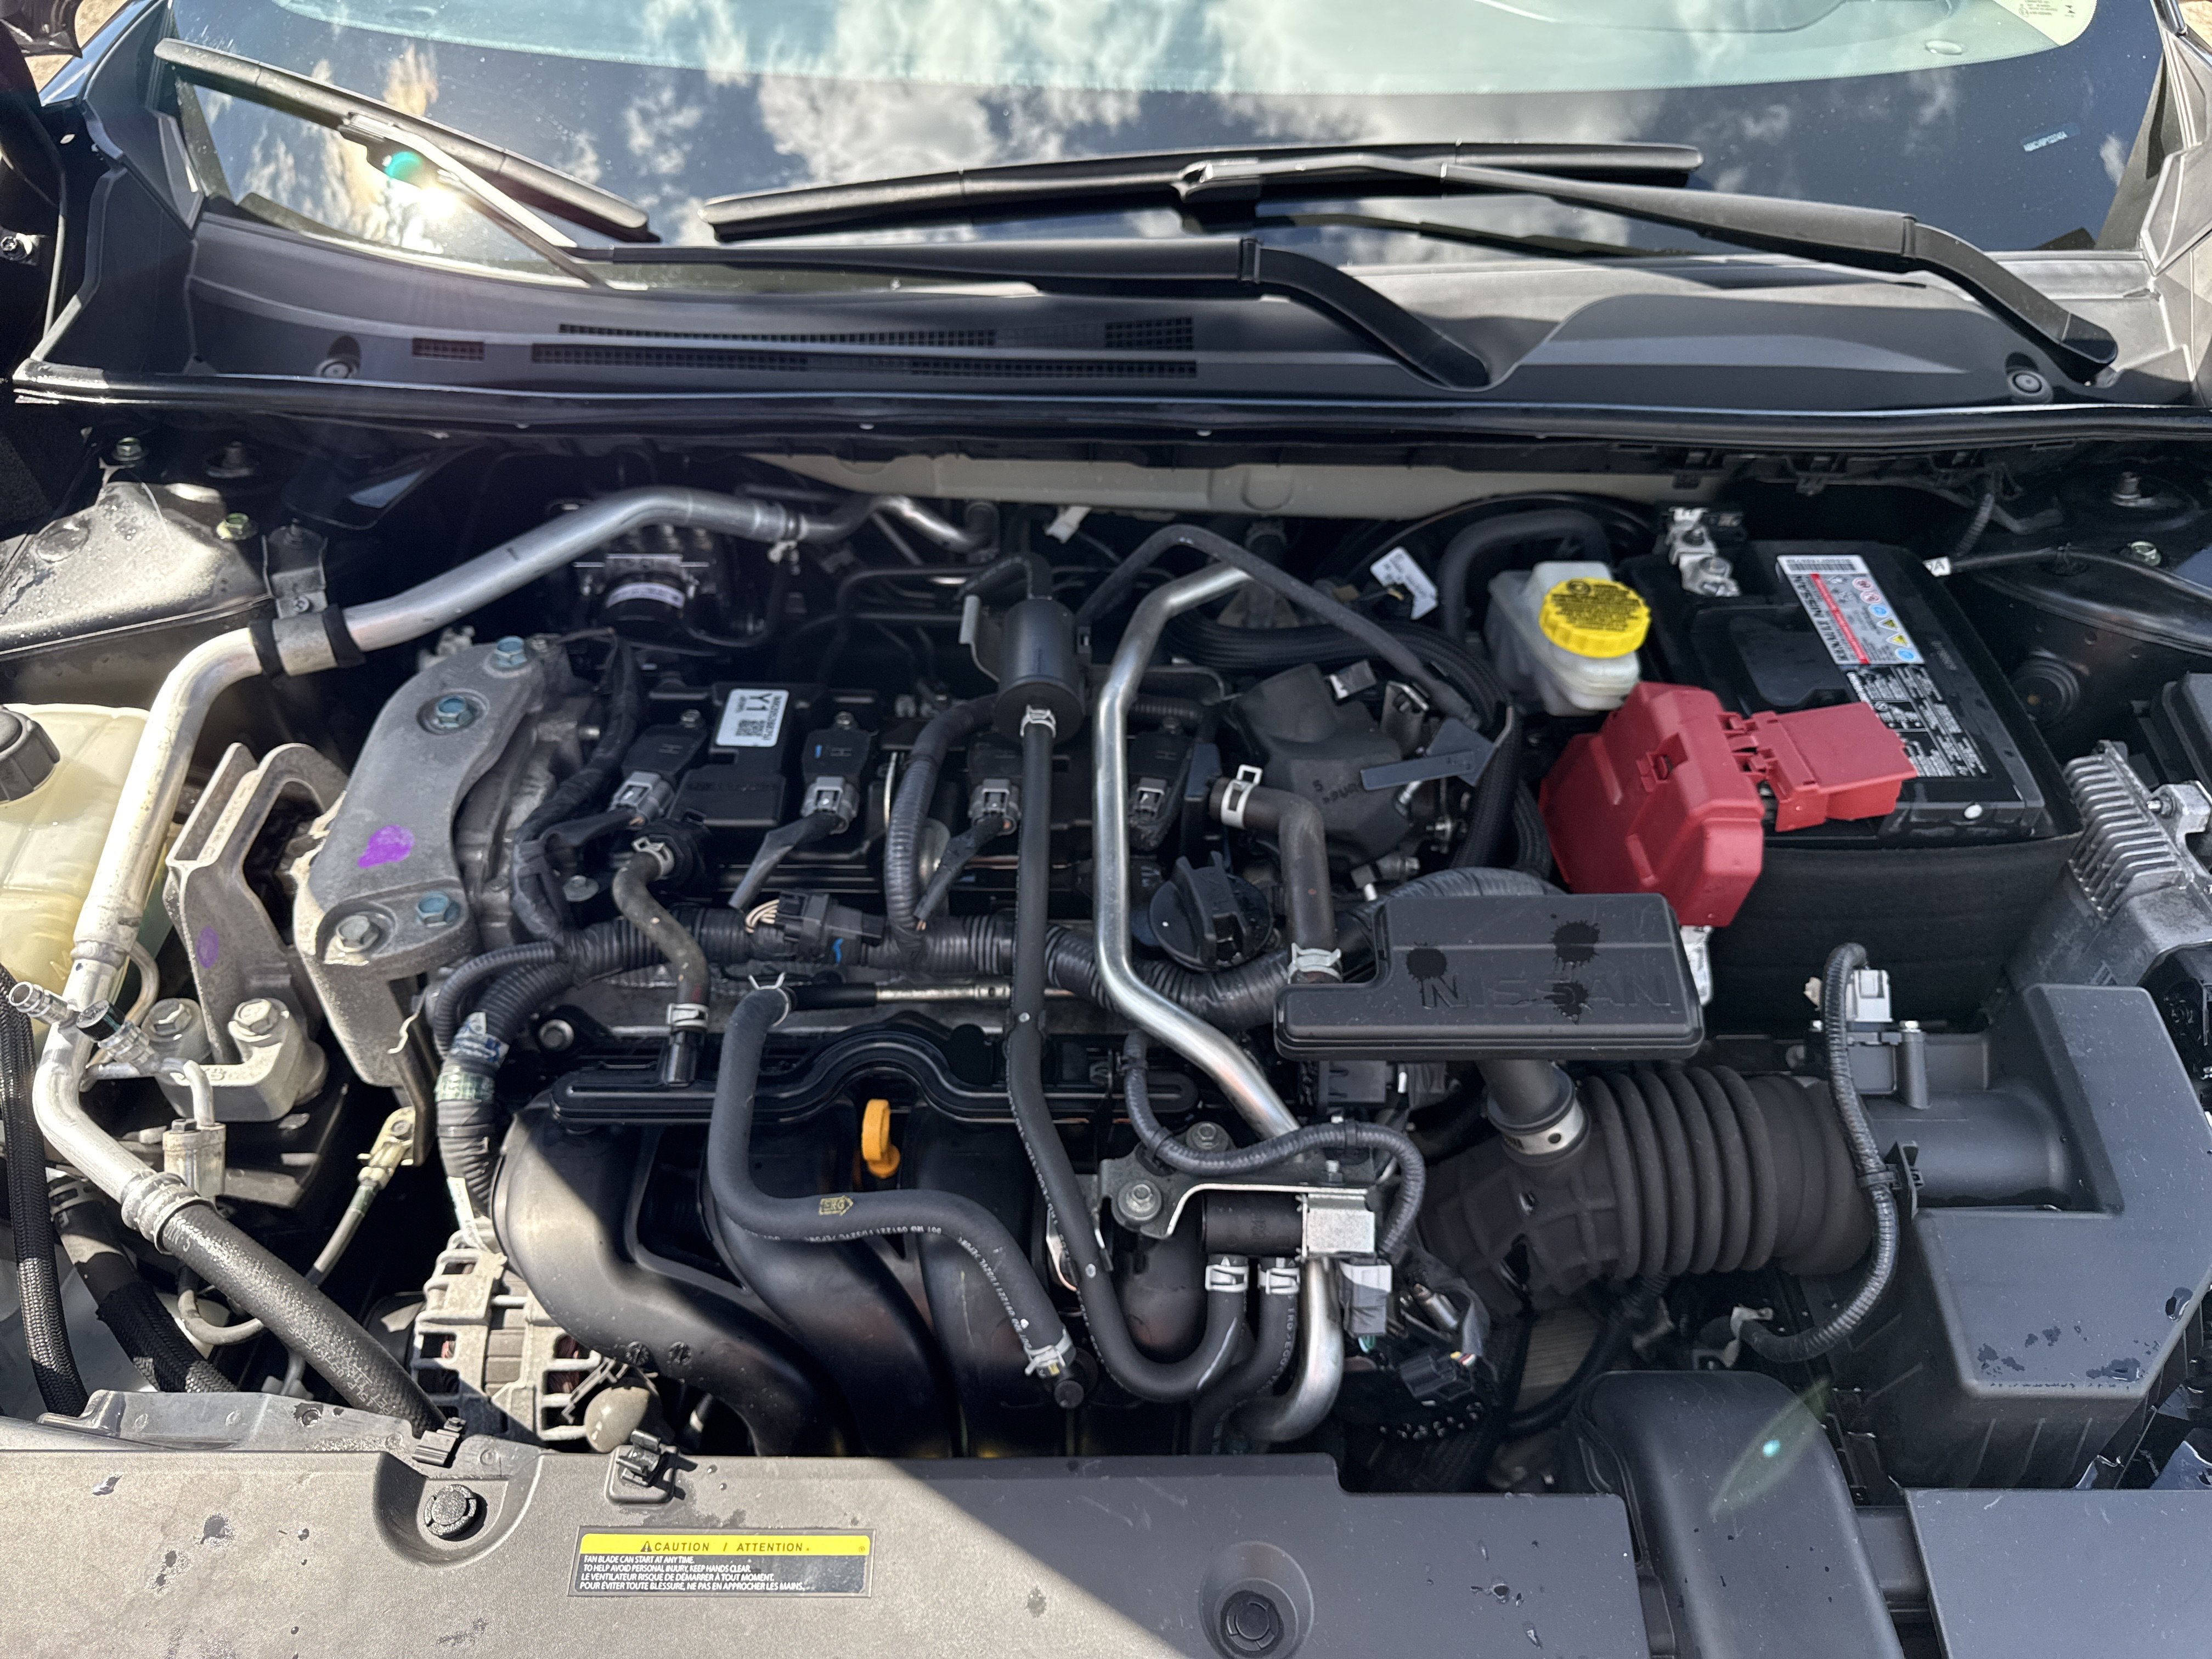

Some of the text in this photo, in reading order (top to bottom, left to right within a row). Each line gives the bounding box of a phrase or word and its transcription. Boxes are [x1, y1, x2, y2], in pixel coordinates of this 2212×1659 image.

[746, 693, 773, 711] Y1
[1421, 975, 1672, 1008] NISSAN
[654, 1542, 710, 1551] CAUTION
[584, 1564, 592, 1572] TO
[594, 1564, 609, 1572] HELP
[611, 1564, 630, 1572] AVOID
[631, 1564, 664, 1572] PERSONAL
[690, 1565, 706, 1573] KEEP
[706, 1565, 729, 1573] HANDS
[581, 1573, 590, 1581] LE
[591, 1573, 636, 1581] VENTILATEUR
[637, 1573, 663, 1581] RISQUE
[664, 1573, 675, 1581] DE
[675, 1573, 713, 1581] DÉMARRER
[721, 1573, 741, 1582] TOUT
[580, 1582, 600, 1590] POUR
[601, 1582, 625, 1590] ÉVITER
[626, 1582, 649, 1590] TOUTE
[687, 1582, 697, 1590] NE
[698, 1582, 710, 1590] PAS
[712, 1582, 723, 1590] EN
[723, 1582, 765, 1590] APPROCHER
[766, 1582, 778, 1590] LES
